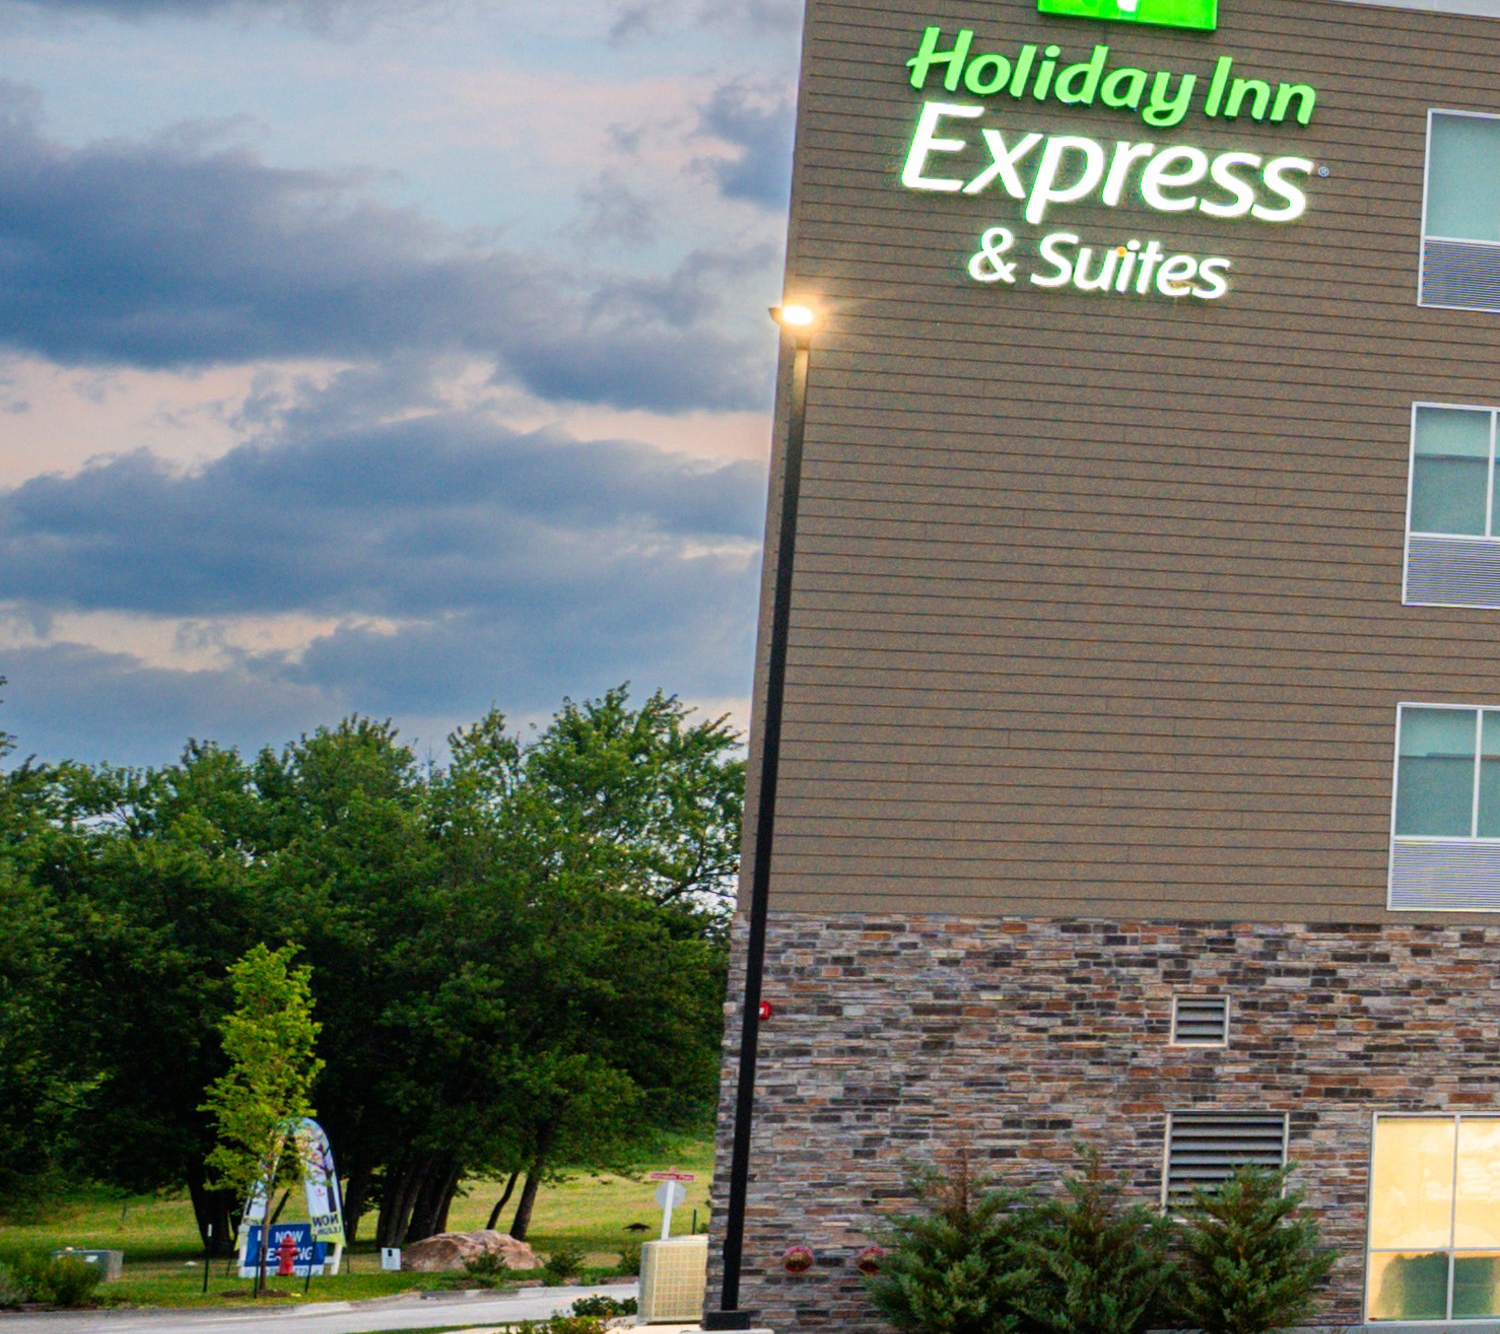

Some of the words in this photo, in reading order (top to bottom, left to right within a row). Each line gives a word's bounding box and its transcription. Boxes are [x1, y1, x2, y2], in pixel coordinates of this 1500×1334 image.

[907, 26, 1196, 127] Holiday
[1205, 56, 1317, 125] Inn
[901, 101, 1315, 224] Express
[967, 227, 1016, 283] &
[1030, 232, 1231, 299] Suites
